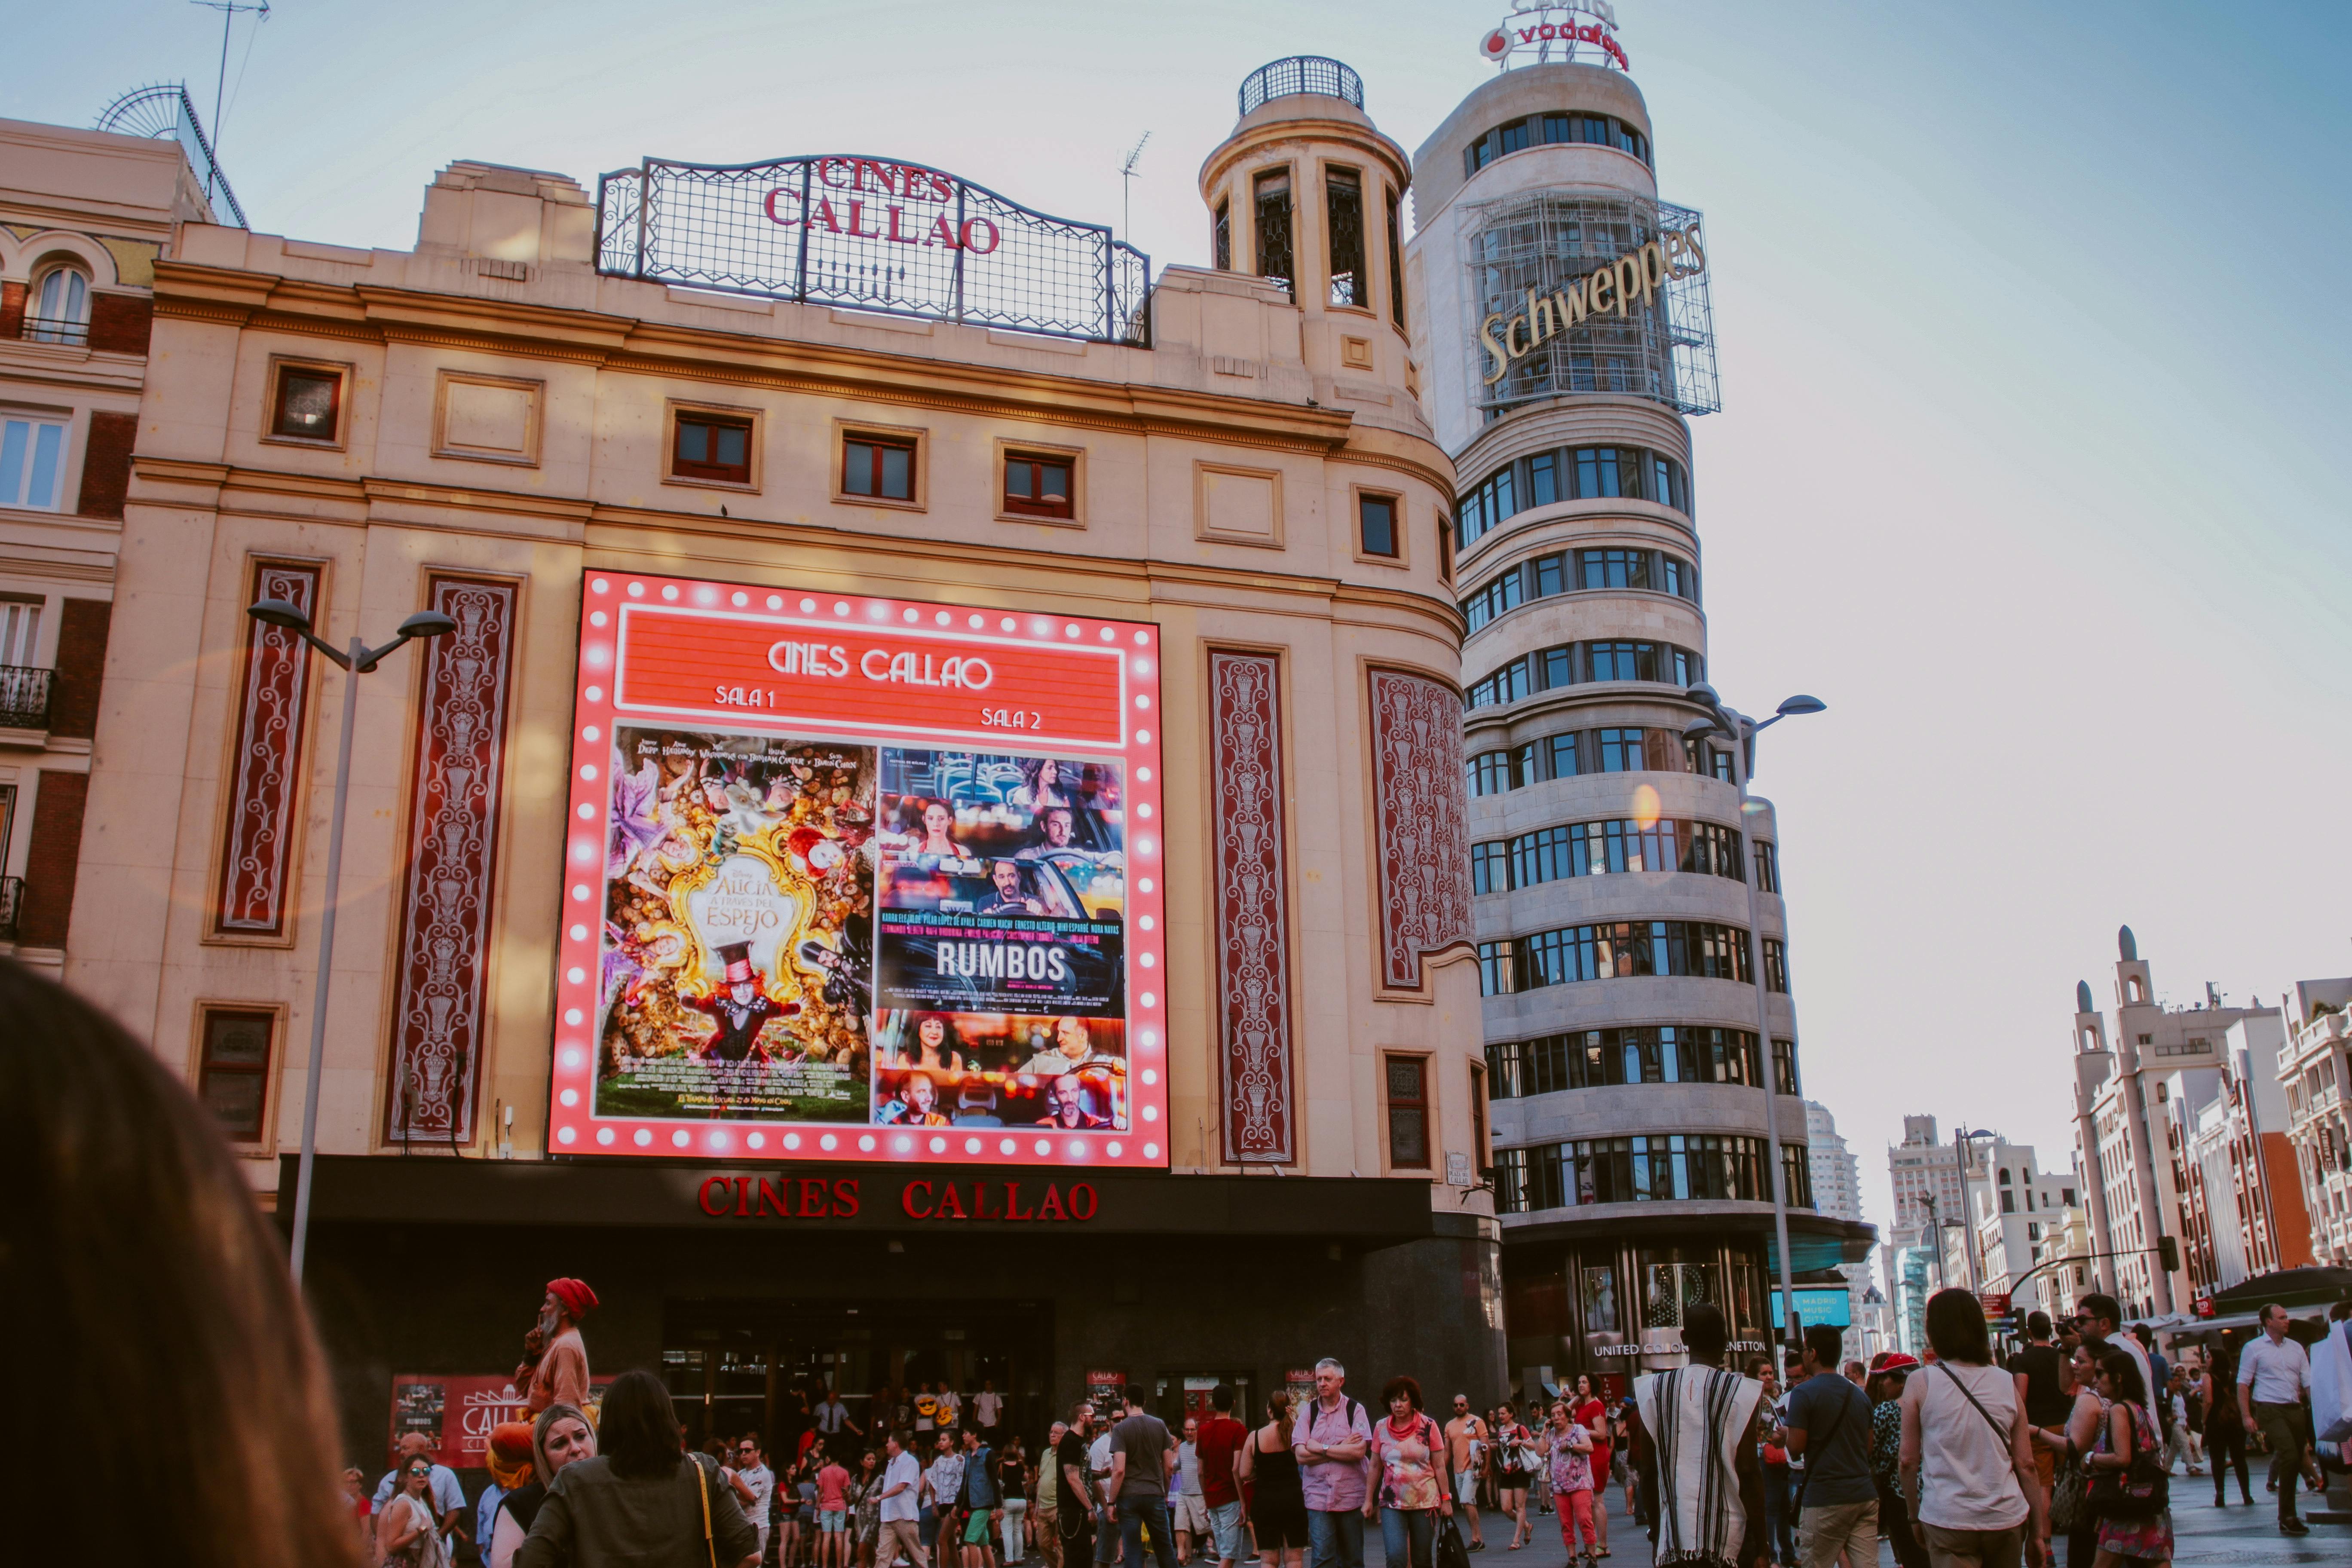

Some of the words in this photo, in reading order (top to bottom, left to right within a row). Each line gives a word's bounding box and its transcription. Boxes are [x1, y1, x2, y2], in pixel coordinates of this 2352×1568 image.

[1518, 18, 1629, 72] vodafone
[818, 156, 952, 203] CINES
[764, 187, 999, 254] CALLAO
[1480, 223, 1706, 386] Schweppes
[768, 641, 848, 677] CINES
[861, 649, 993, 690] CALLAO
[714, 686, 761, 707] SALA
[767, 691, 774, 707] 1
[981, 708, 1024, 729] SALA
[1030, 712, 1041, 730] 2
[756, 898, 773, 907] DEL
[707, 908, 778, 935] ESPEJO
[977, 918, 997, 928] CARMEN
[937, 941, 1065, 981] RUMBOS
[698, 1176, 859, 1218] CINES
[902, 1180, 1098, 1220] CALLAO
[1595, 1344, 1639, 1356] UNITED
[1644, 1343, 1689, 1354] COLOR
[462, 1407, 508, 1435] CALL
